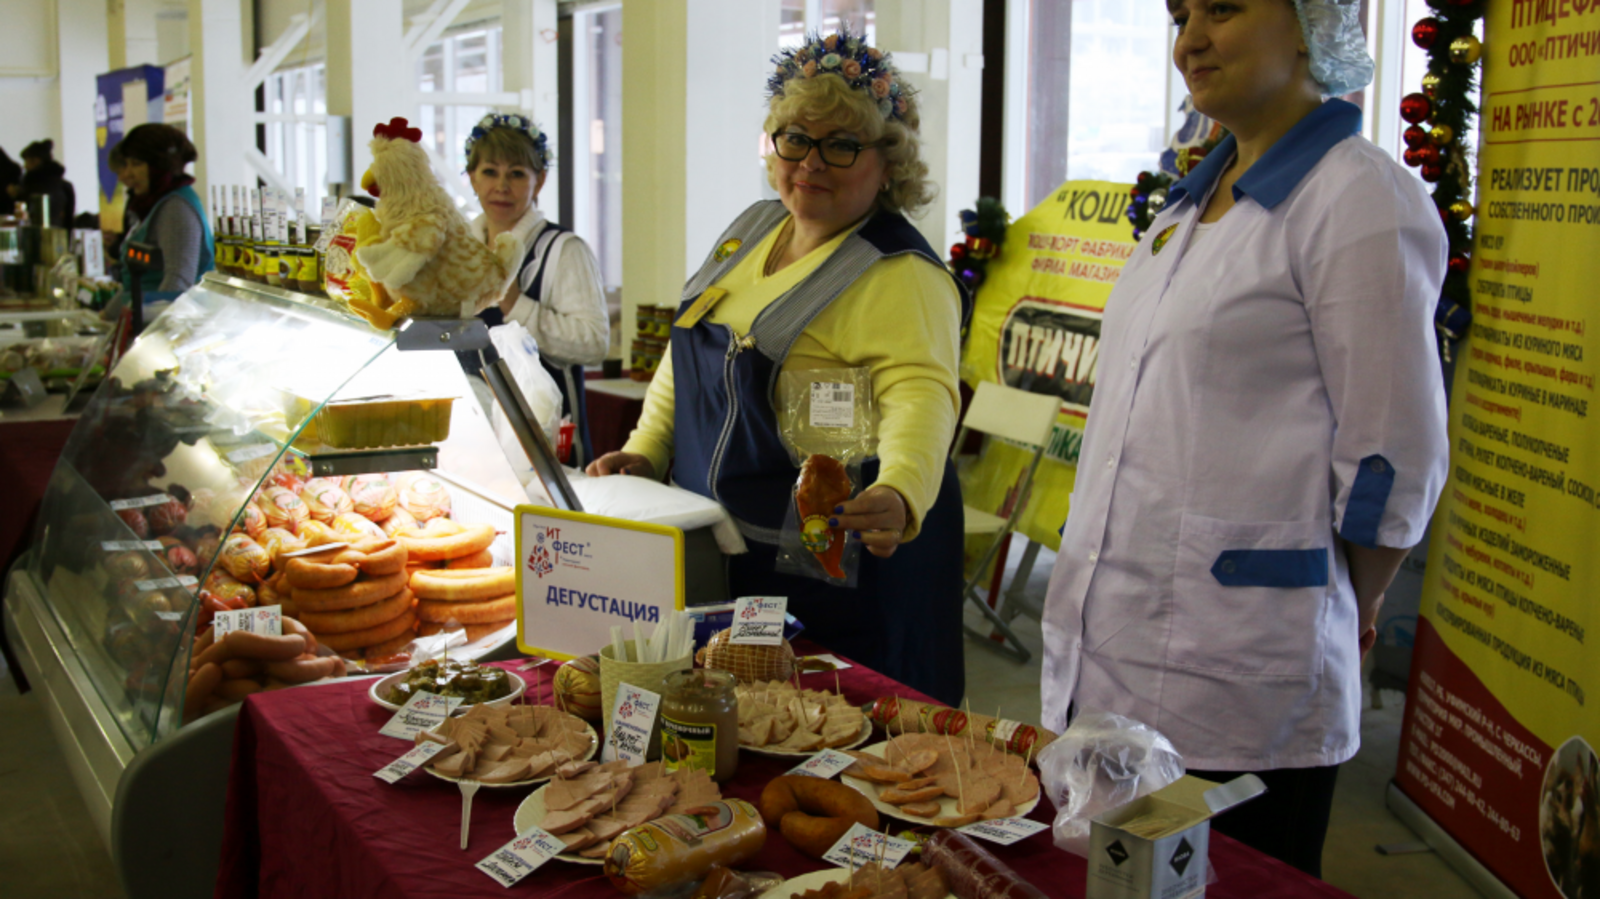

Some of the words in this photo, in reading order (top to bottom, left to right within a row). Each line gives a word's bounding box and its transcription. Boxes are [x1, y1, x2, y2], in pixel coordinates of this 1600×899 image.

[1509, 41, 1536, 68] ООО
[1492, 105, 1511, 133] НА
[1514, 100, 1568, 132] РЫНКЕ
[1490, 168, 1564, 192] РЕАЛИЗУЕТ
[1567, 168, 1600, 198] ПРО
[1488, 201, 1565, 223] СОБСТВЕННОГО
[1513, 332, 1524, 349] ИЗ
[1524, 334, 1561, 358] КУРИНОГО
[1562, 344, 1584, 363] МЯСА
[1549, 395, 1588, 419] МАРИНАДЕ
[552, 540, 585, 556] ФЕСТ
[546, 585, 660, 623] ДЕГУСТАЦИЯ
[1544, 665, 1566, 691] МЯСА
